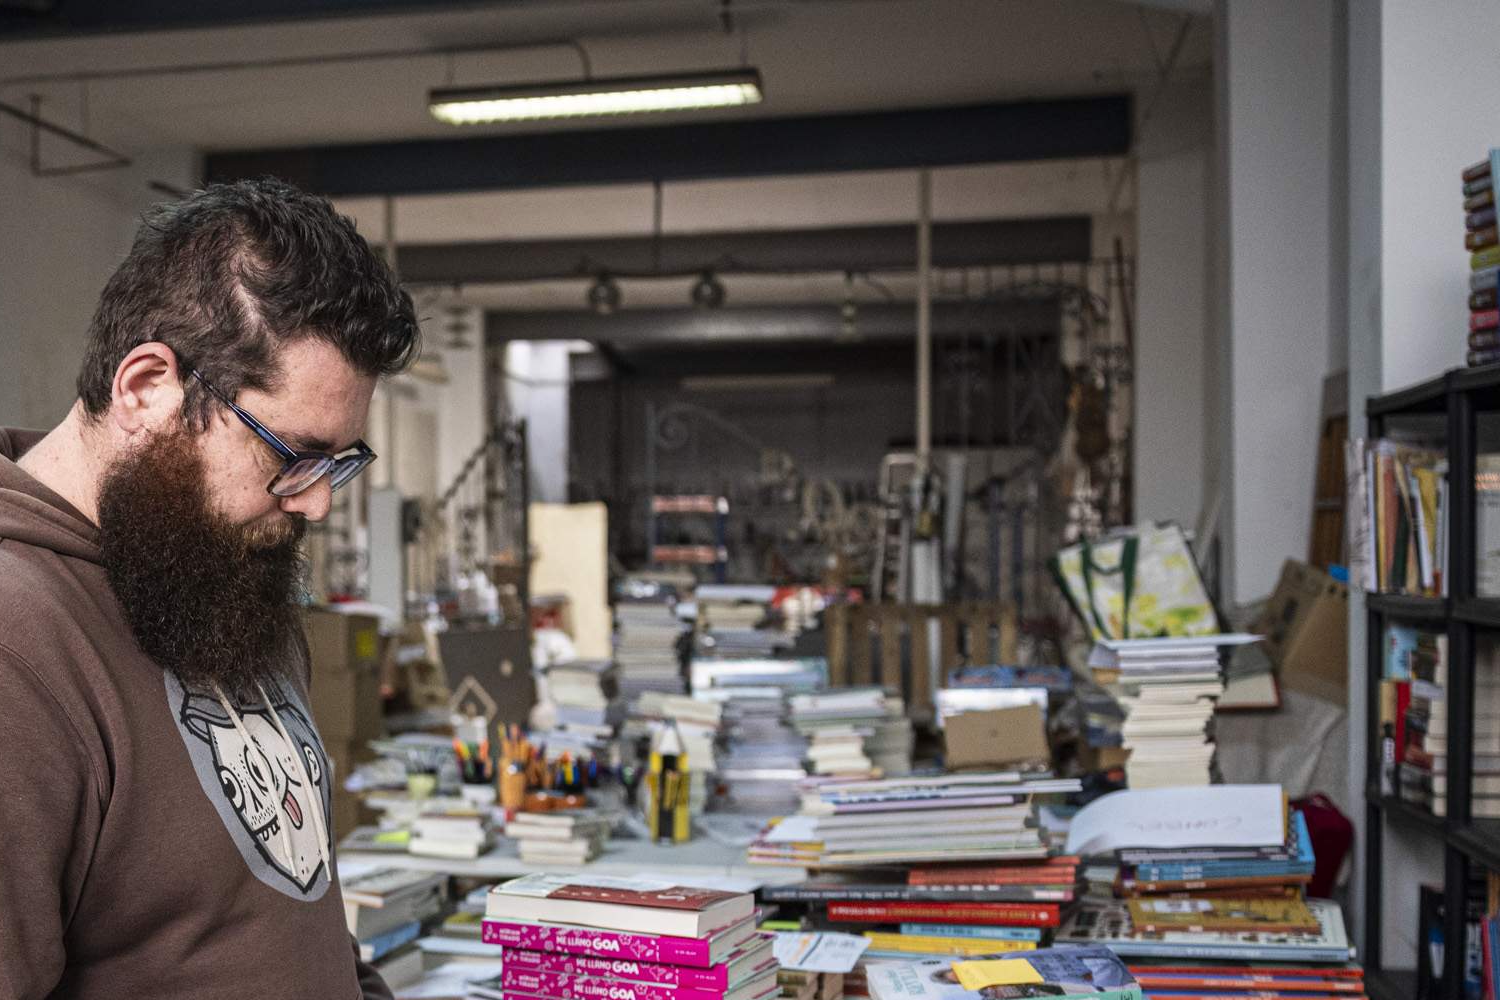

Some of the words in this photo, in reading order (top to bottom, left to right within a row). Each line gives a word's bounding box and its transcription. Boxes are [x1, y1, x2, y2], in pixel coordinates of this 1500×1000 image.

[593, 937, 620, 952] GOA
[612, 961, 639, 975] GOA
[610, 987, 636, 1000] GOA
